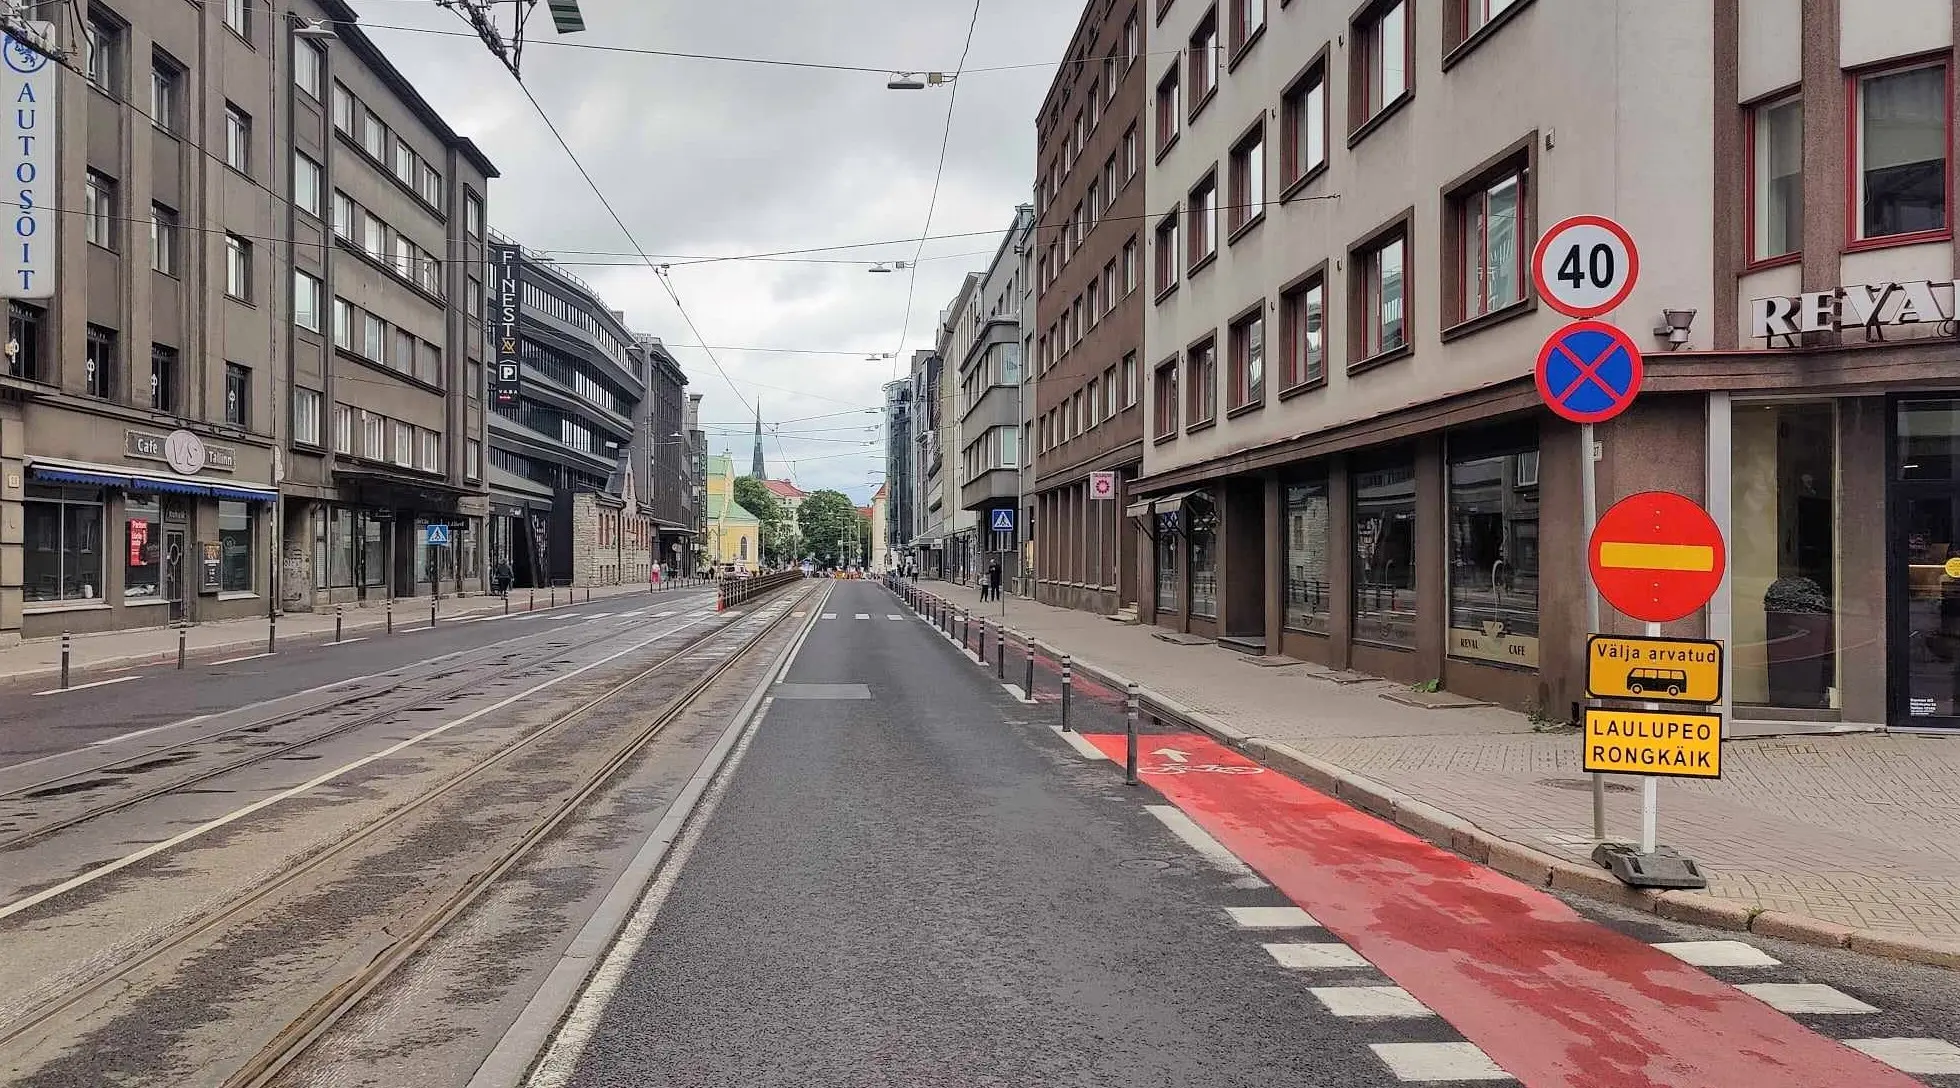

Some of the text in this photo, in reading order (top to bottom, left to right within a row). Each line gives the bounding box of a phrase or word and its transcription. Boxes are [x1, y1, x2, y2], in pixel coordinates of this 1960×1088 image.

[16, 82, 37, 291] AUTOSÕIT
[1557, 243, 1614, 289] 40
[501, 250, 516, 337] FINEST
[1750, 279, 1960, 338] REVA
[137, 438, 158, 454] Café
[208, 450, 233, 466] Tallinn
[1508, 644, 1526, 656] CAFE
[1597, 643, 1716, 663] Välja arvatud
[1593, 719, 1711, 740] LAULUPEO
[1592, 745, 1712, 768] RONGKÄIK
